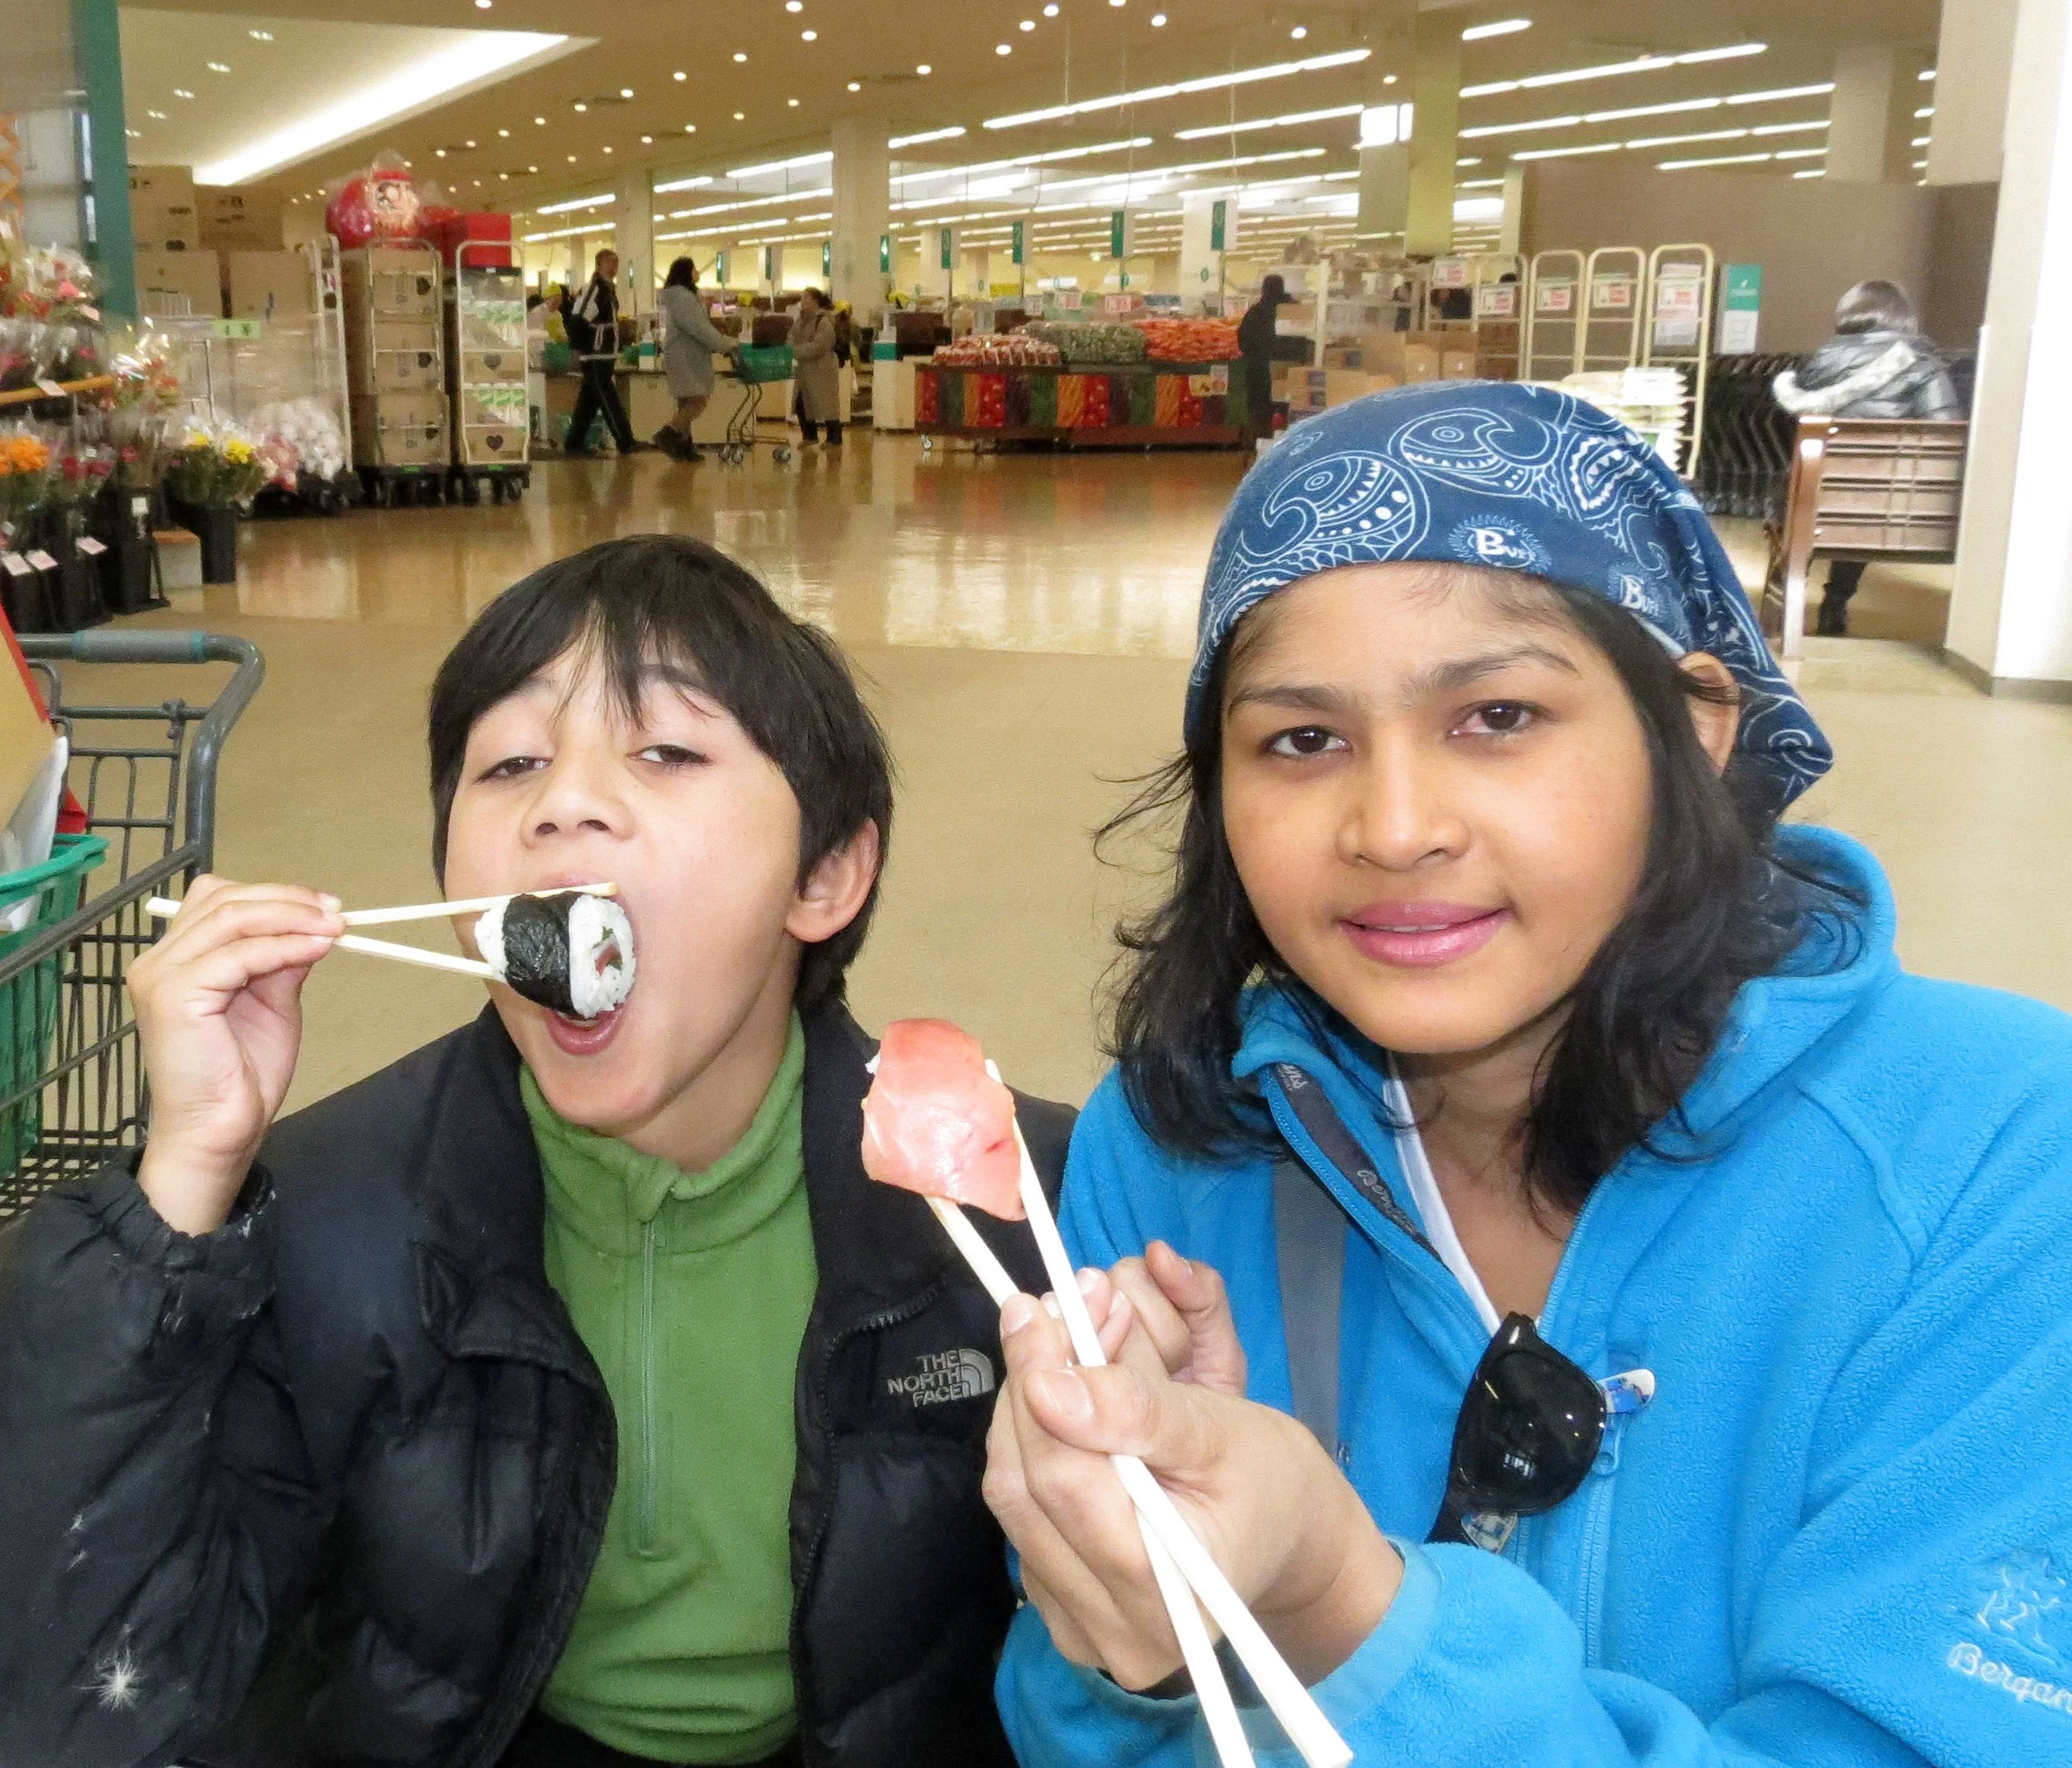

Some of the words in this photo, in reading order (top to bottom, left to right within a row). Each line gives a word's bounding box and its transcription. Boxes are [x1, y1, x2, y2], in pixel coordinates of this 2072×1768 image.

[916, 1350, 960, 1373] THE
[887, 1367, 961, 1394] NORTH
[913, 1383, 963, 1407] FACE
